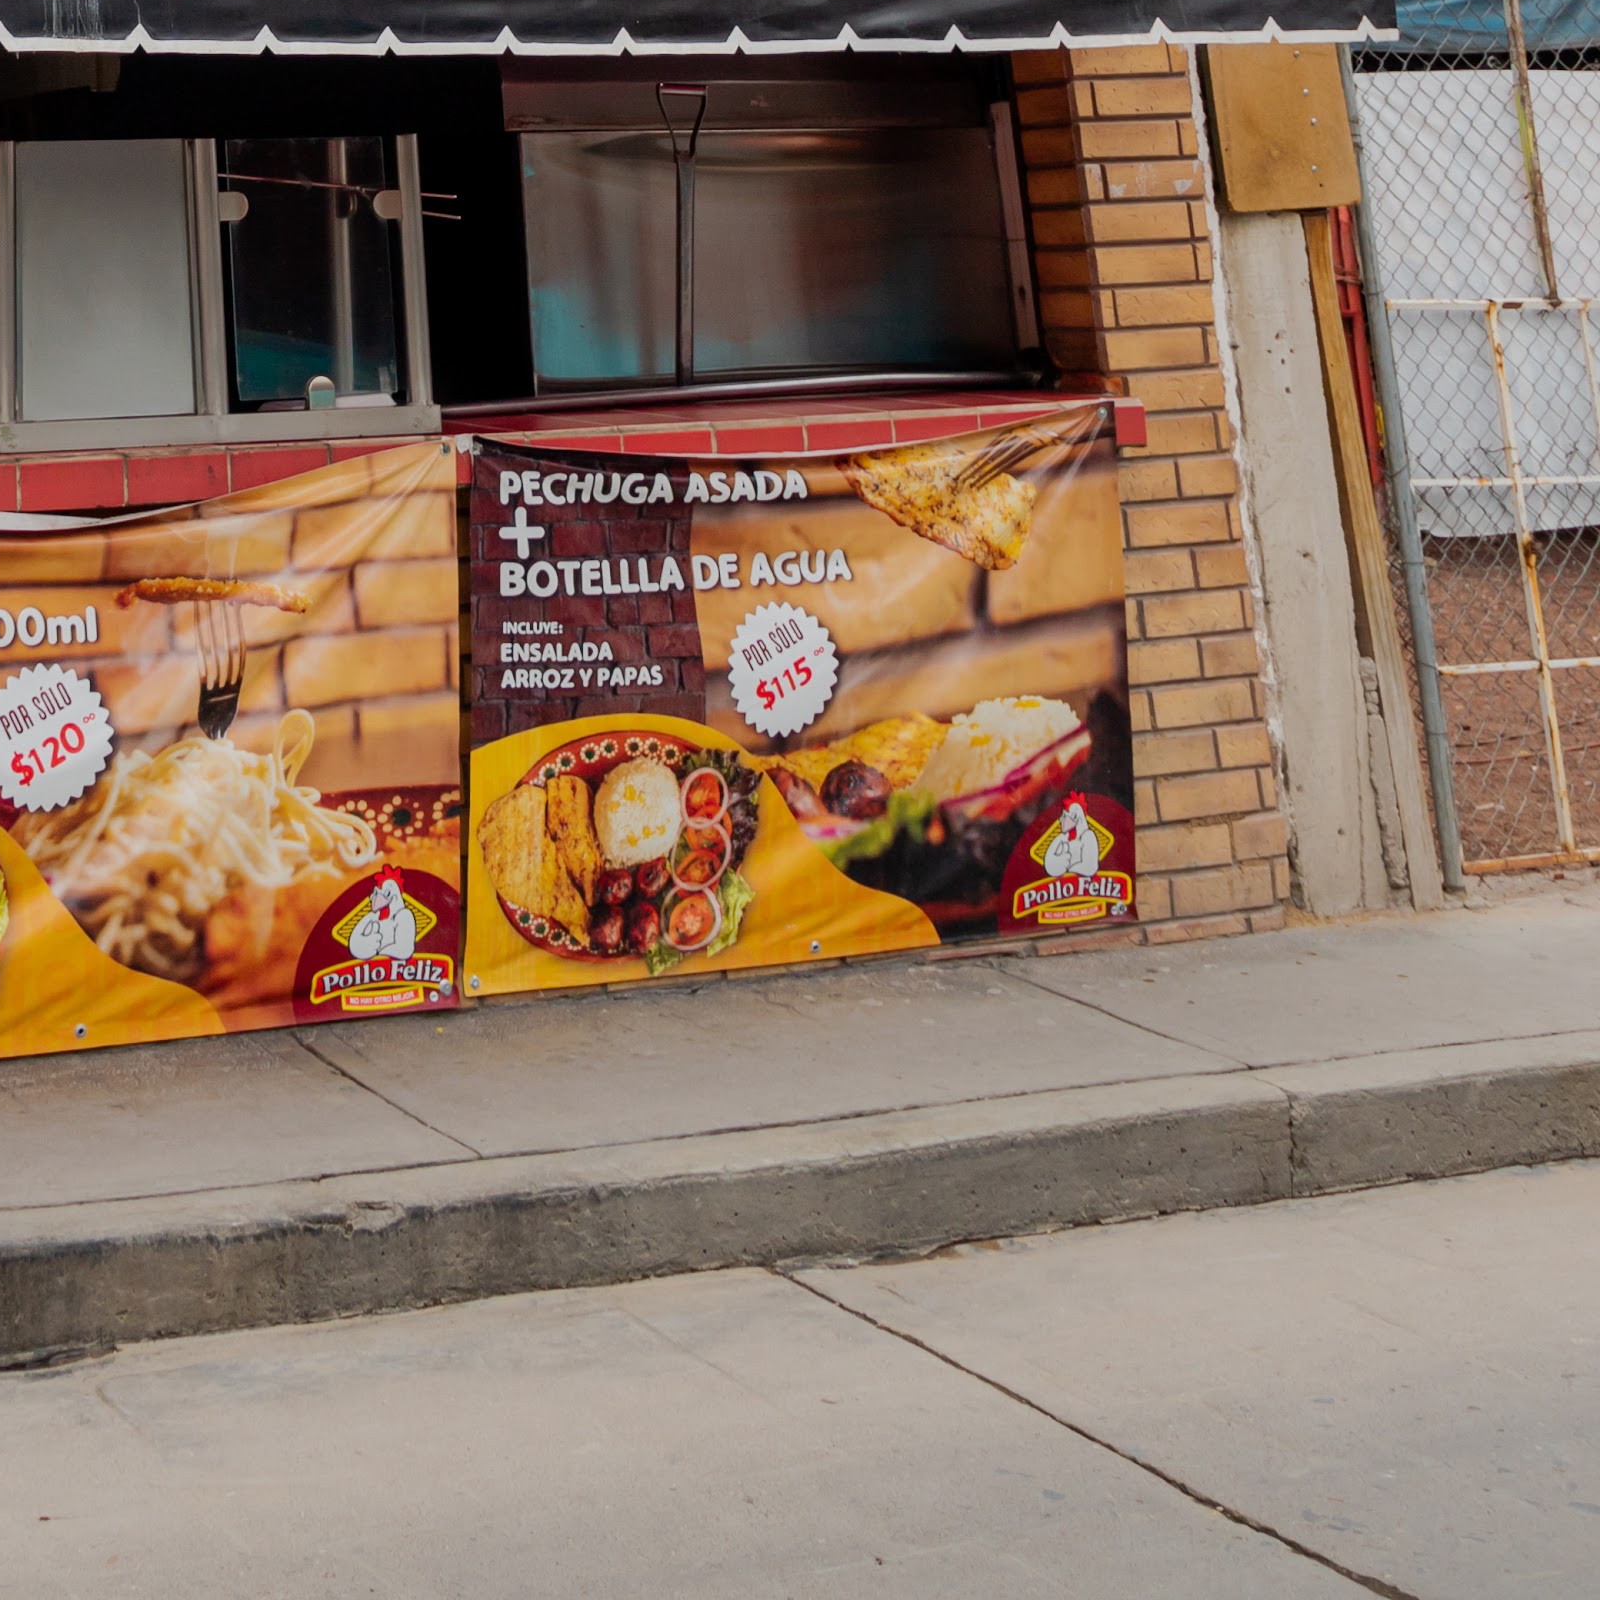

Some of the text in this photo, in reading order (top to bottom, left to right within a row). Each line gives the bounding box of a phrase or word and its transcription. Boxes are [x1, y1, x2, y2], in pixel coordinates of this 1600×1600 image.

[499, 469, 809, 506] PECHUGA ASADA
[499, 548, 853, 598] BOTELLLA DE AGUA
[502, 621, 564, 635] INCLUYE:
[741, 618, 804, 672] POR SÓLO
[500, 641, 614, 663] ENSALADA
[501, 664, 664, 689] ARROZ Y PAPAS
[755, 656, 813, 711] $115
[31, 682, 73, 721] SÓLO
[10, 722, 86, 788] $120
[1022, 876, 1122, 910] Pollo Feliz
[322, 959, 444, 994] Pollo Feliz
